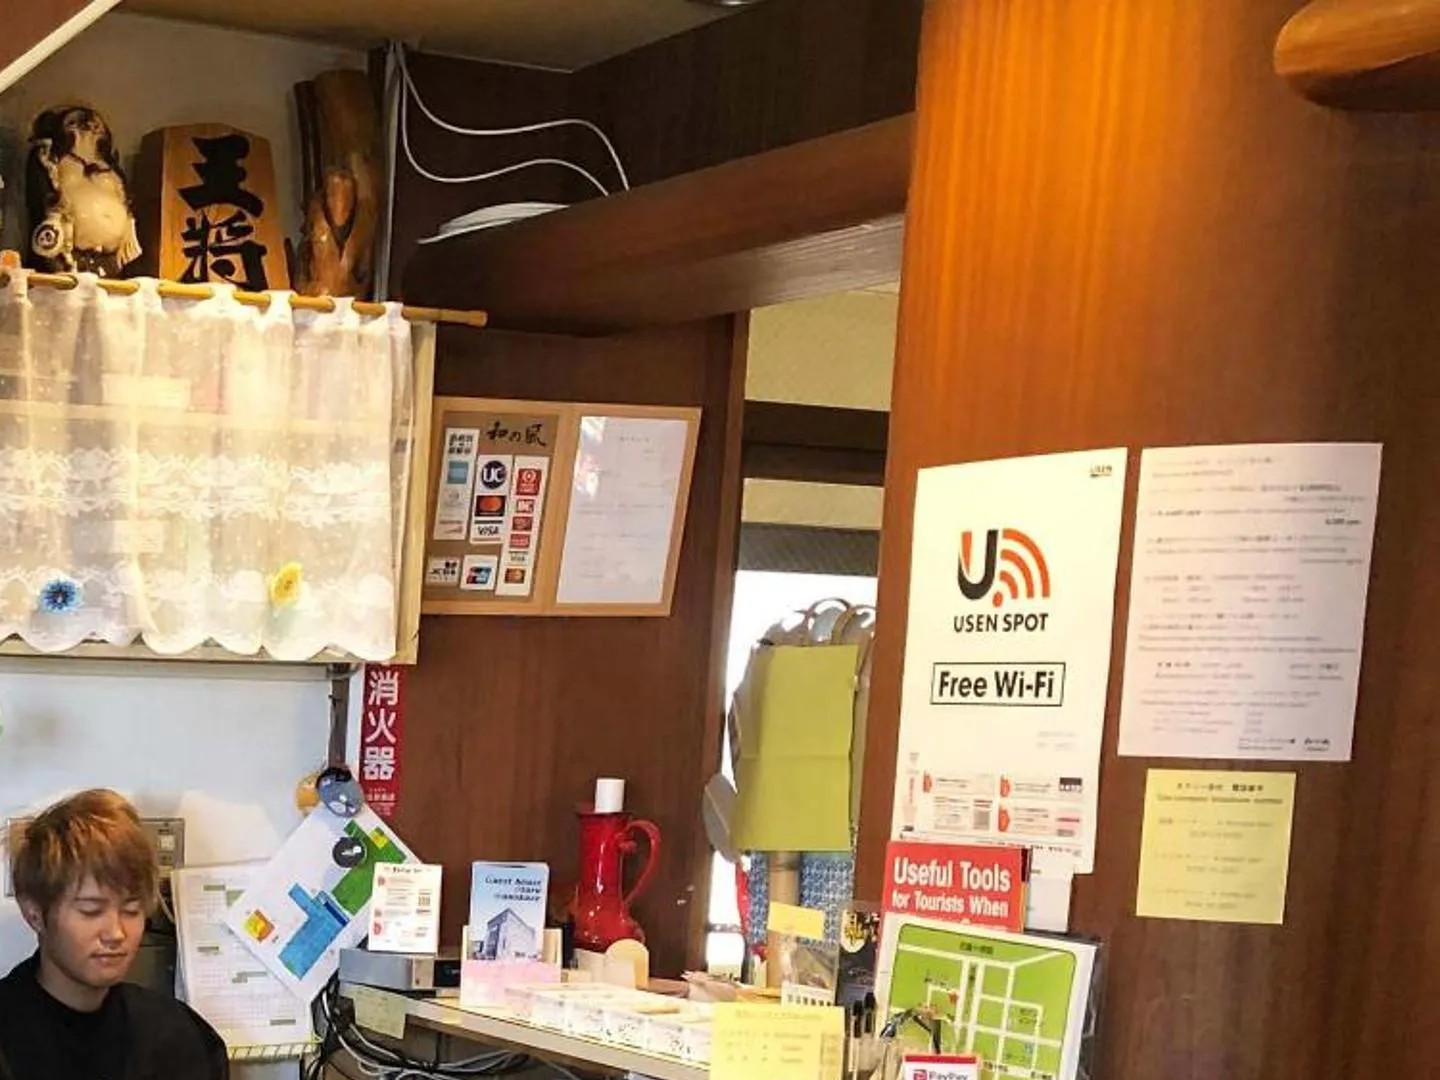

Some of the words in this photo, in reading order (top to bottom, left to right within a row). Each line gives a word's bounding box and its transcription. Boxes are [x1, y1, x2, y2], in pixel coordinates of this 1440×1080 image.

[486, 420, 547, 447] 和の風
[482, 467, 505, 483] UC
[477, 525, 499, 536] VISA
[953, 613, 998, 634] USEN
[1002, 612, 1049, 633] SPOT
[938, 670, 988, 698] Free
[994, 670, 1055, 699] Wi-Fi
[363, 670, 399, 781] 消火器
[894, 856, 953, 887] Useful
[960, 861, 1012, 892] Tools
[891, 890, 910, 908] for
[914, 890, 965, 914] Tourists
[969, 895, 1009, 918] When
